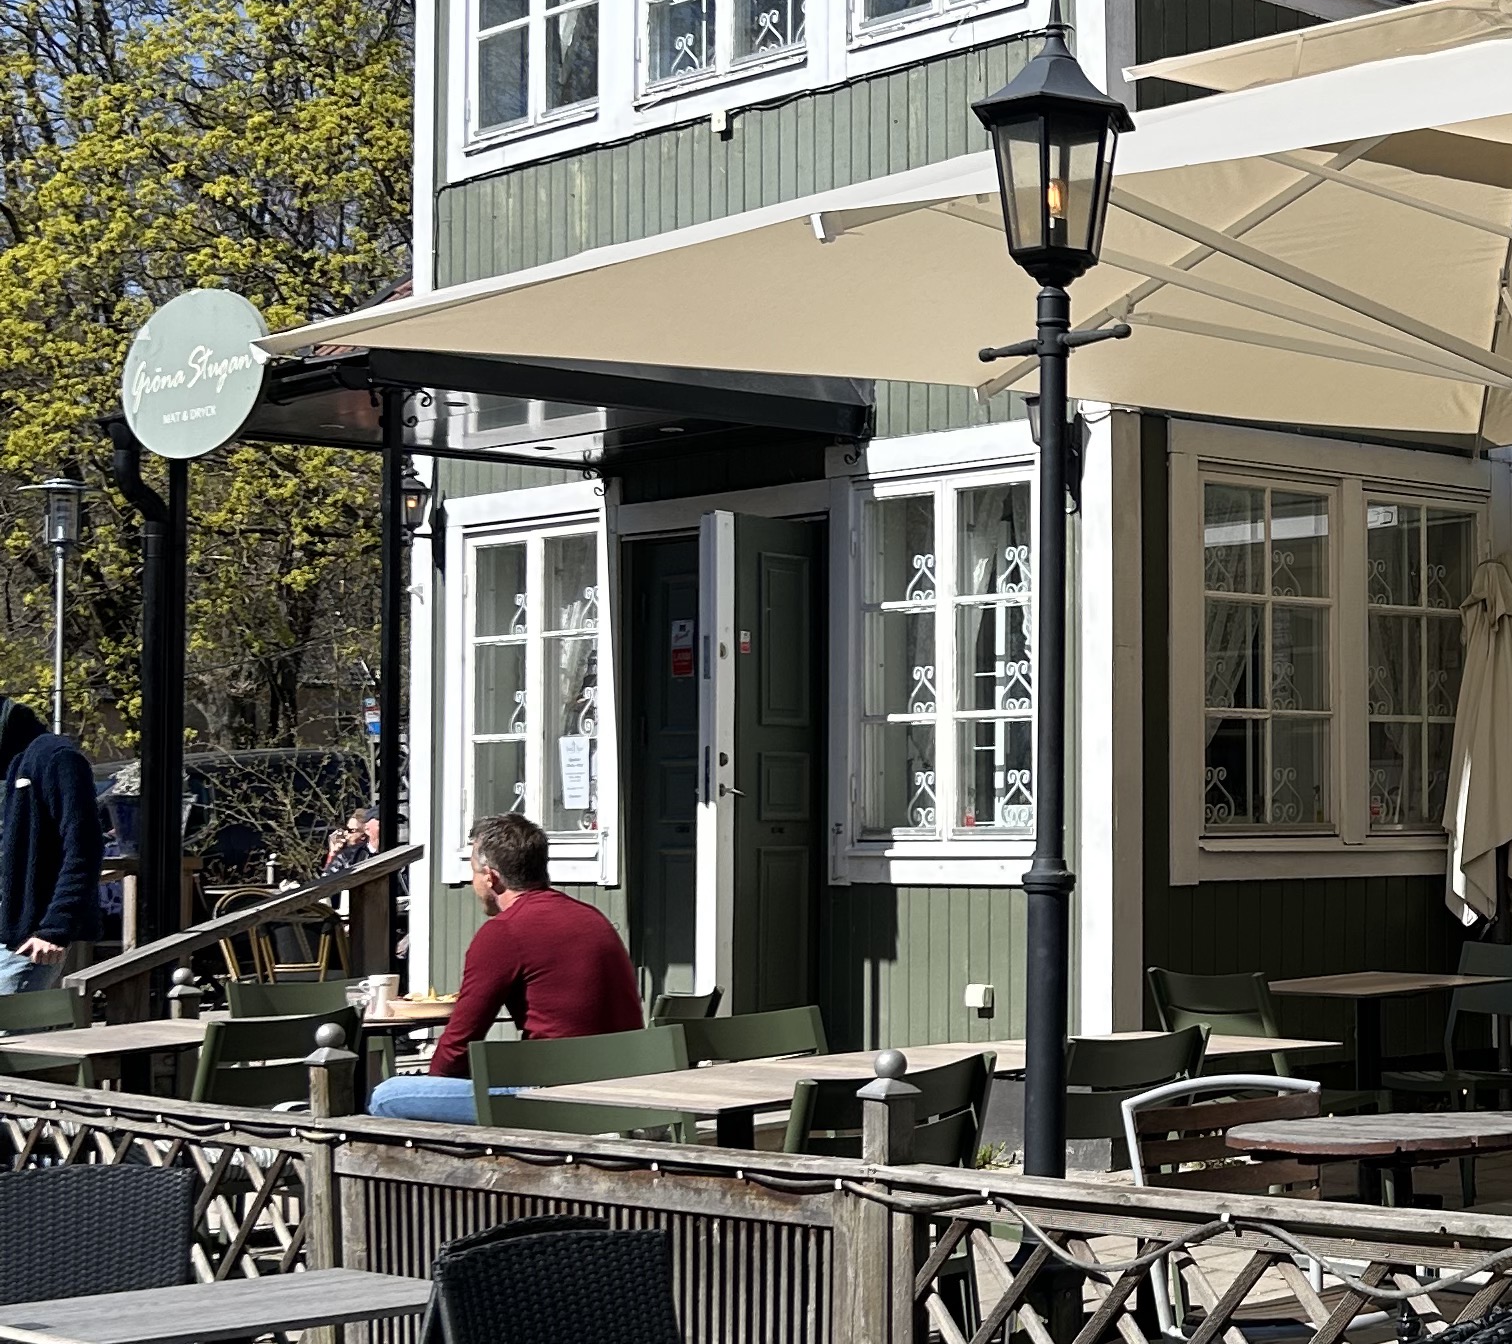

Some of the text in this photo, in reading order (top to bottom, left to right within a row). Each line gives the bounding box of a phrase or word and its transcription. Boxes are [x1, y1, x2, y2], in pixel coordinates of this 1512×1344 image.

[132, 345, 252, 413] Gröna Stugan
[162, 411, 181, 424] MAT
